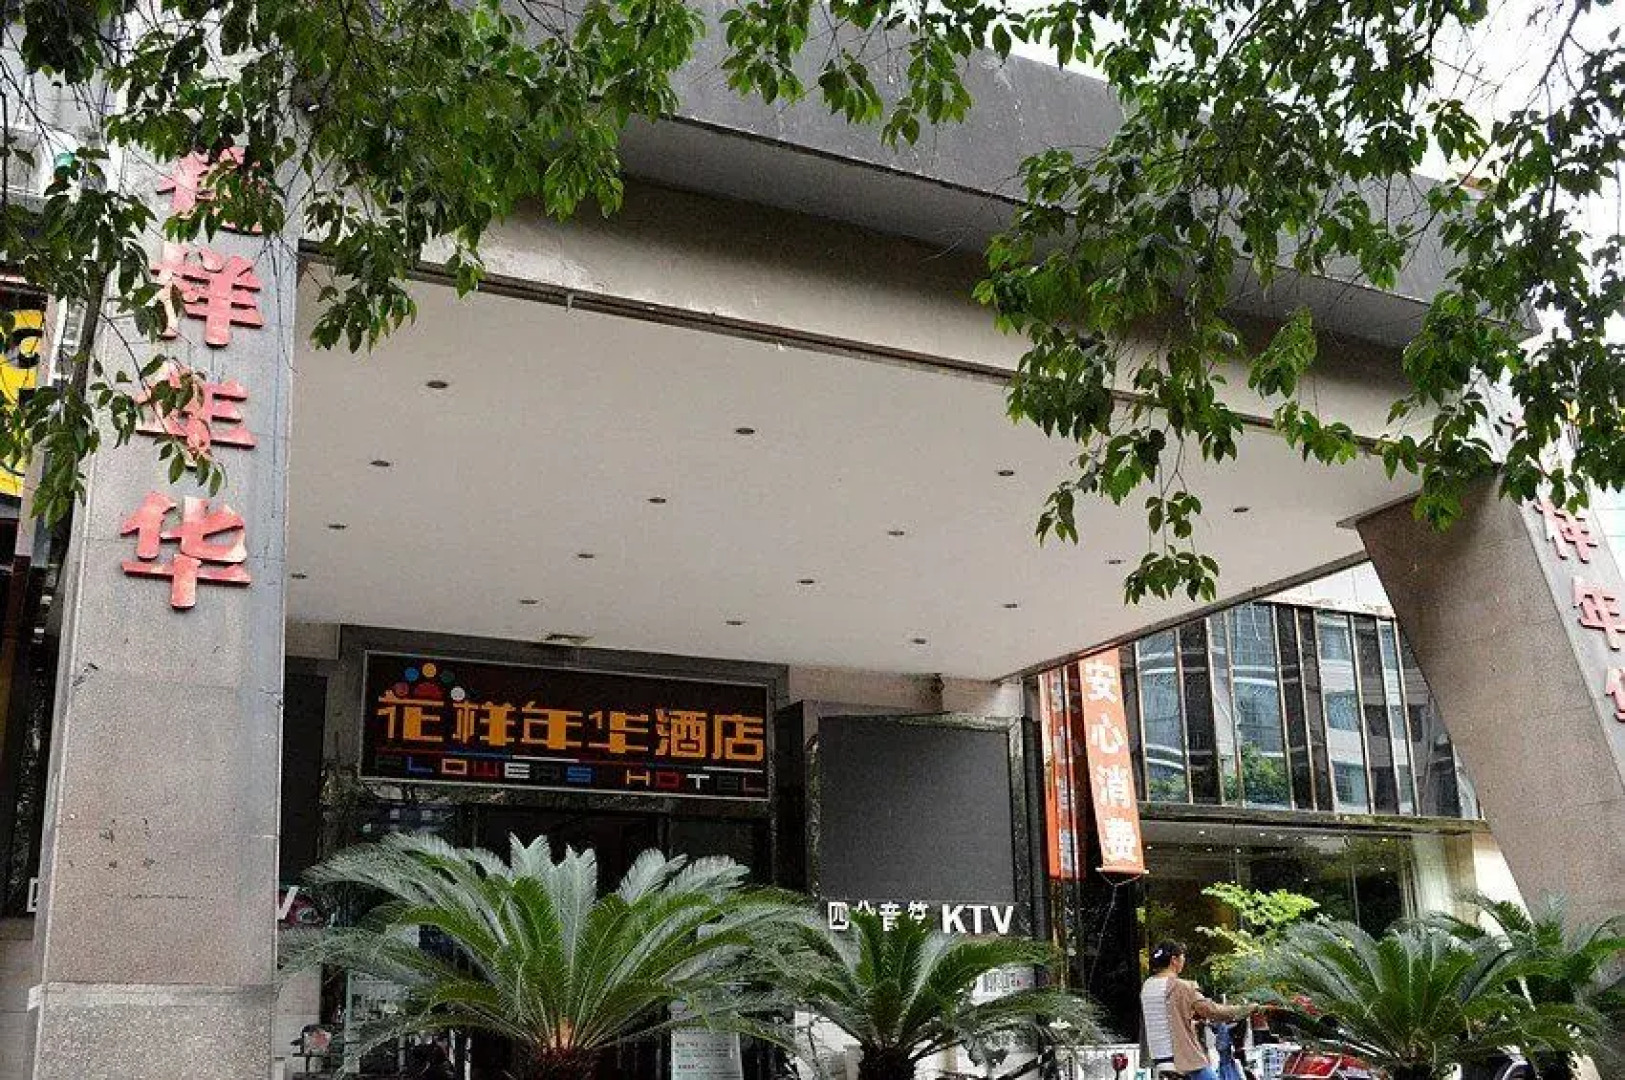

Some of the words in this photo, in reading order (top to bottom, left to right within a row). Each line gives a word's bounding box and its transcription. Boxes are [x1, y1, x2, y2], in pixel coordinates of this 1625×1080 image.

[377, 688, 764, 761] 花样年华酒店
[375, 754, 592, 784] FLOWERS
[626, 769, 765, 793] HOTEL
[941, 903, 1014, 934] KTV
